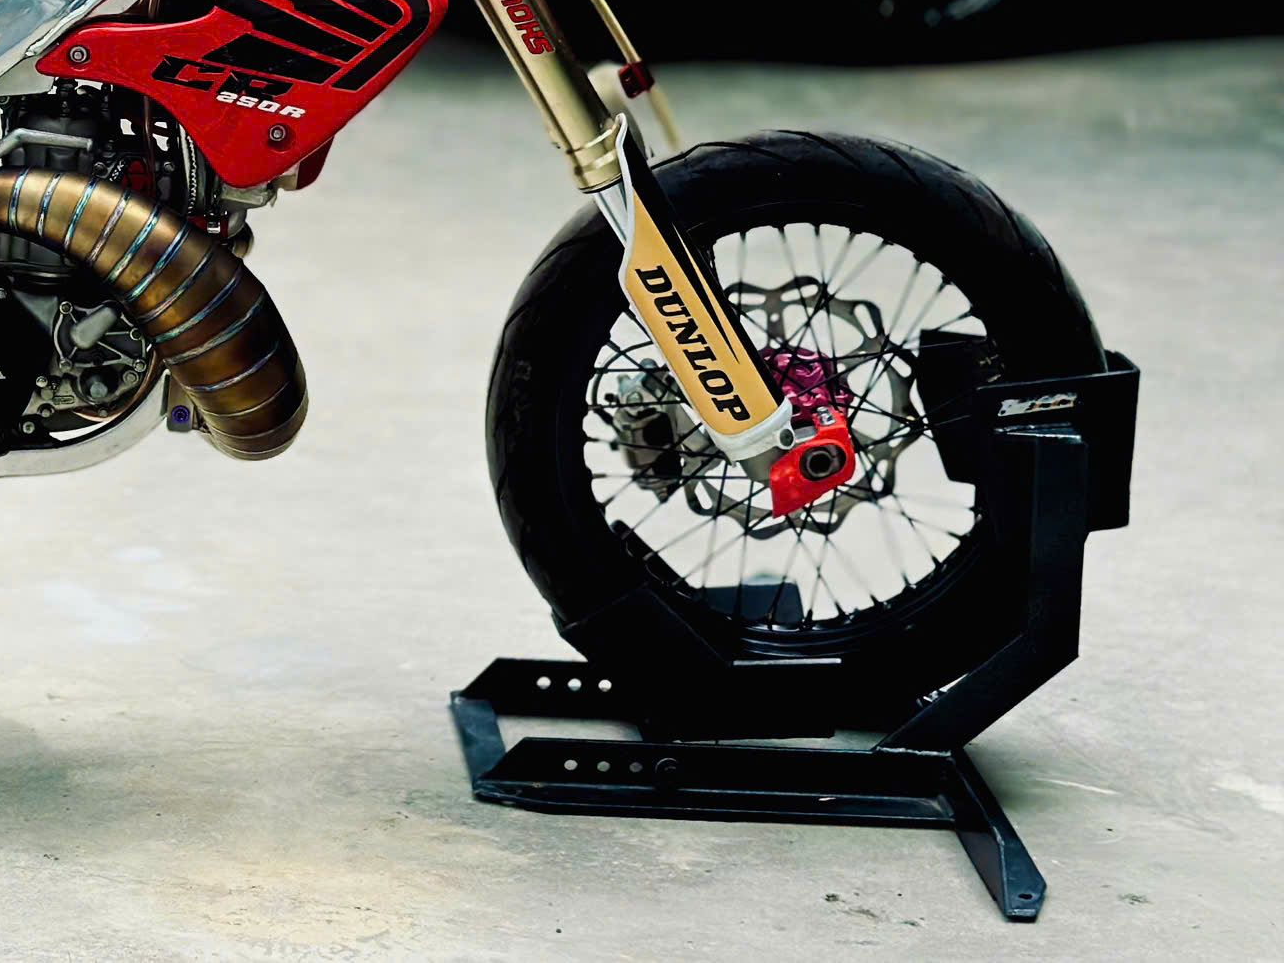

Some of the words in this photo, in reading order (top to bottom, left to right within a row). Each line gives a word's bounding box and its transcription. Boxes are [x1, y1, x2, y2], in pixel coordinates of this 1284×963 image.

[151, 54, 294, 103] CR
[216, 91, 306, 119] 250R
[635, 265, 751, 422] DUNLOP
